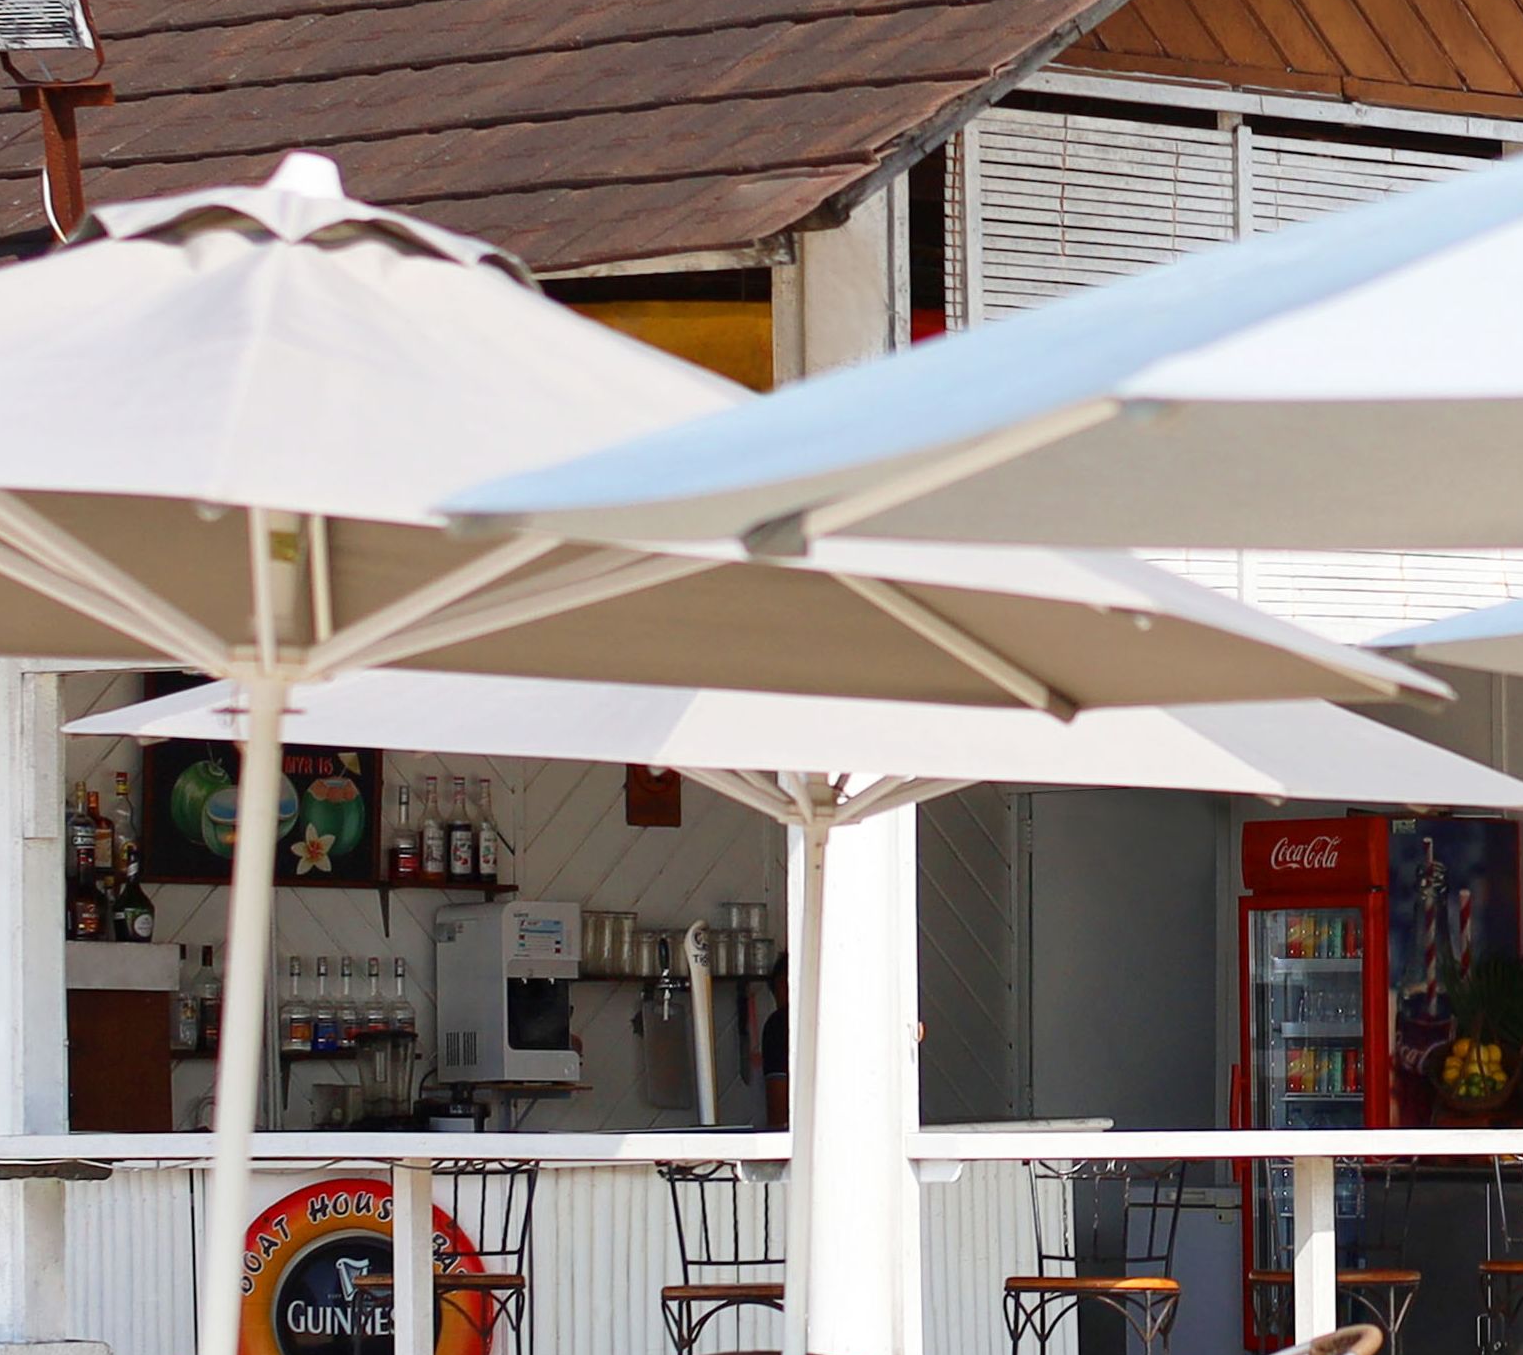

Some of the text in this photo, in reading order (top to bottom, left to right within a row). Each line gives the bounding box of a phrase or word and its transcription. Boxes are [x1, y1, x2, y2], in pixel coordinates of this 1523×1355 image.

[1271, 835, 1342, 870] Coca-Cola
[308, 1191, 393, 1223] HOUS
[432, 1231, 467, 1274] BA
